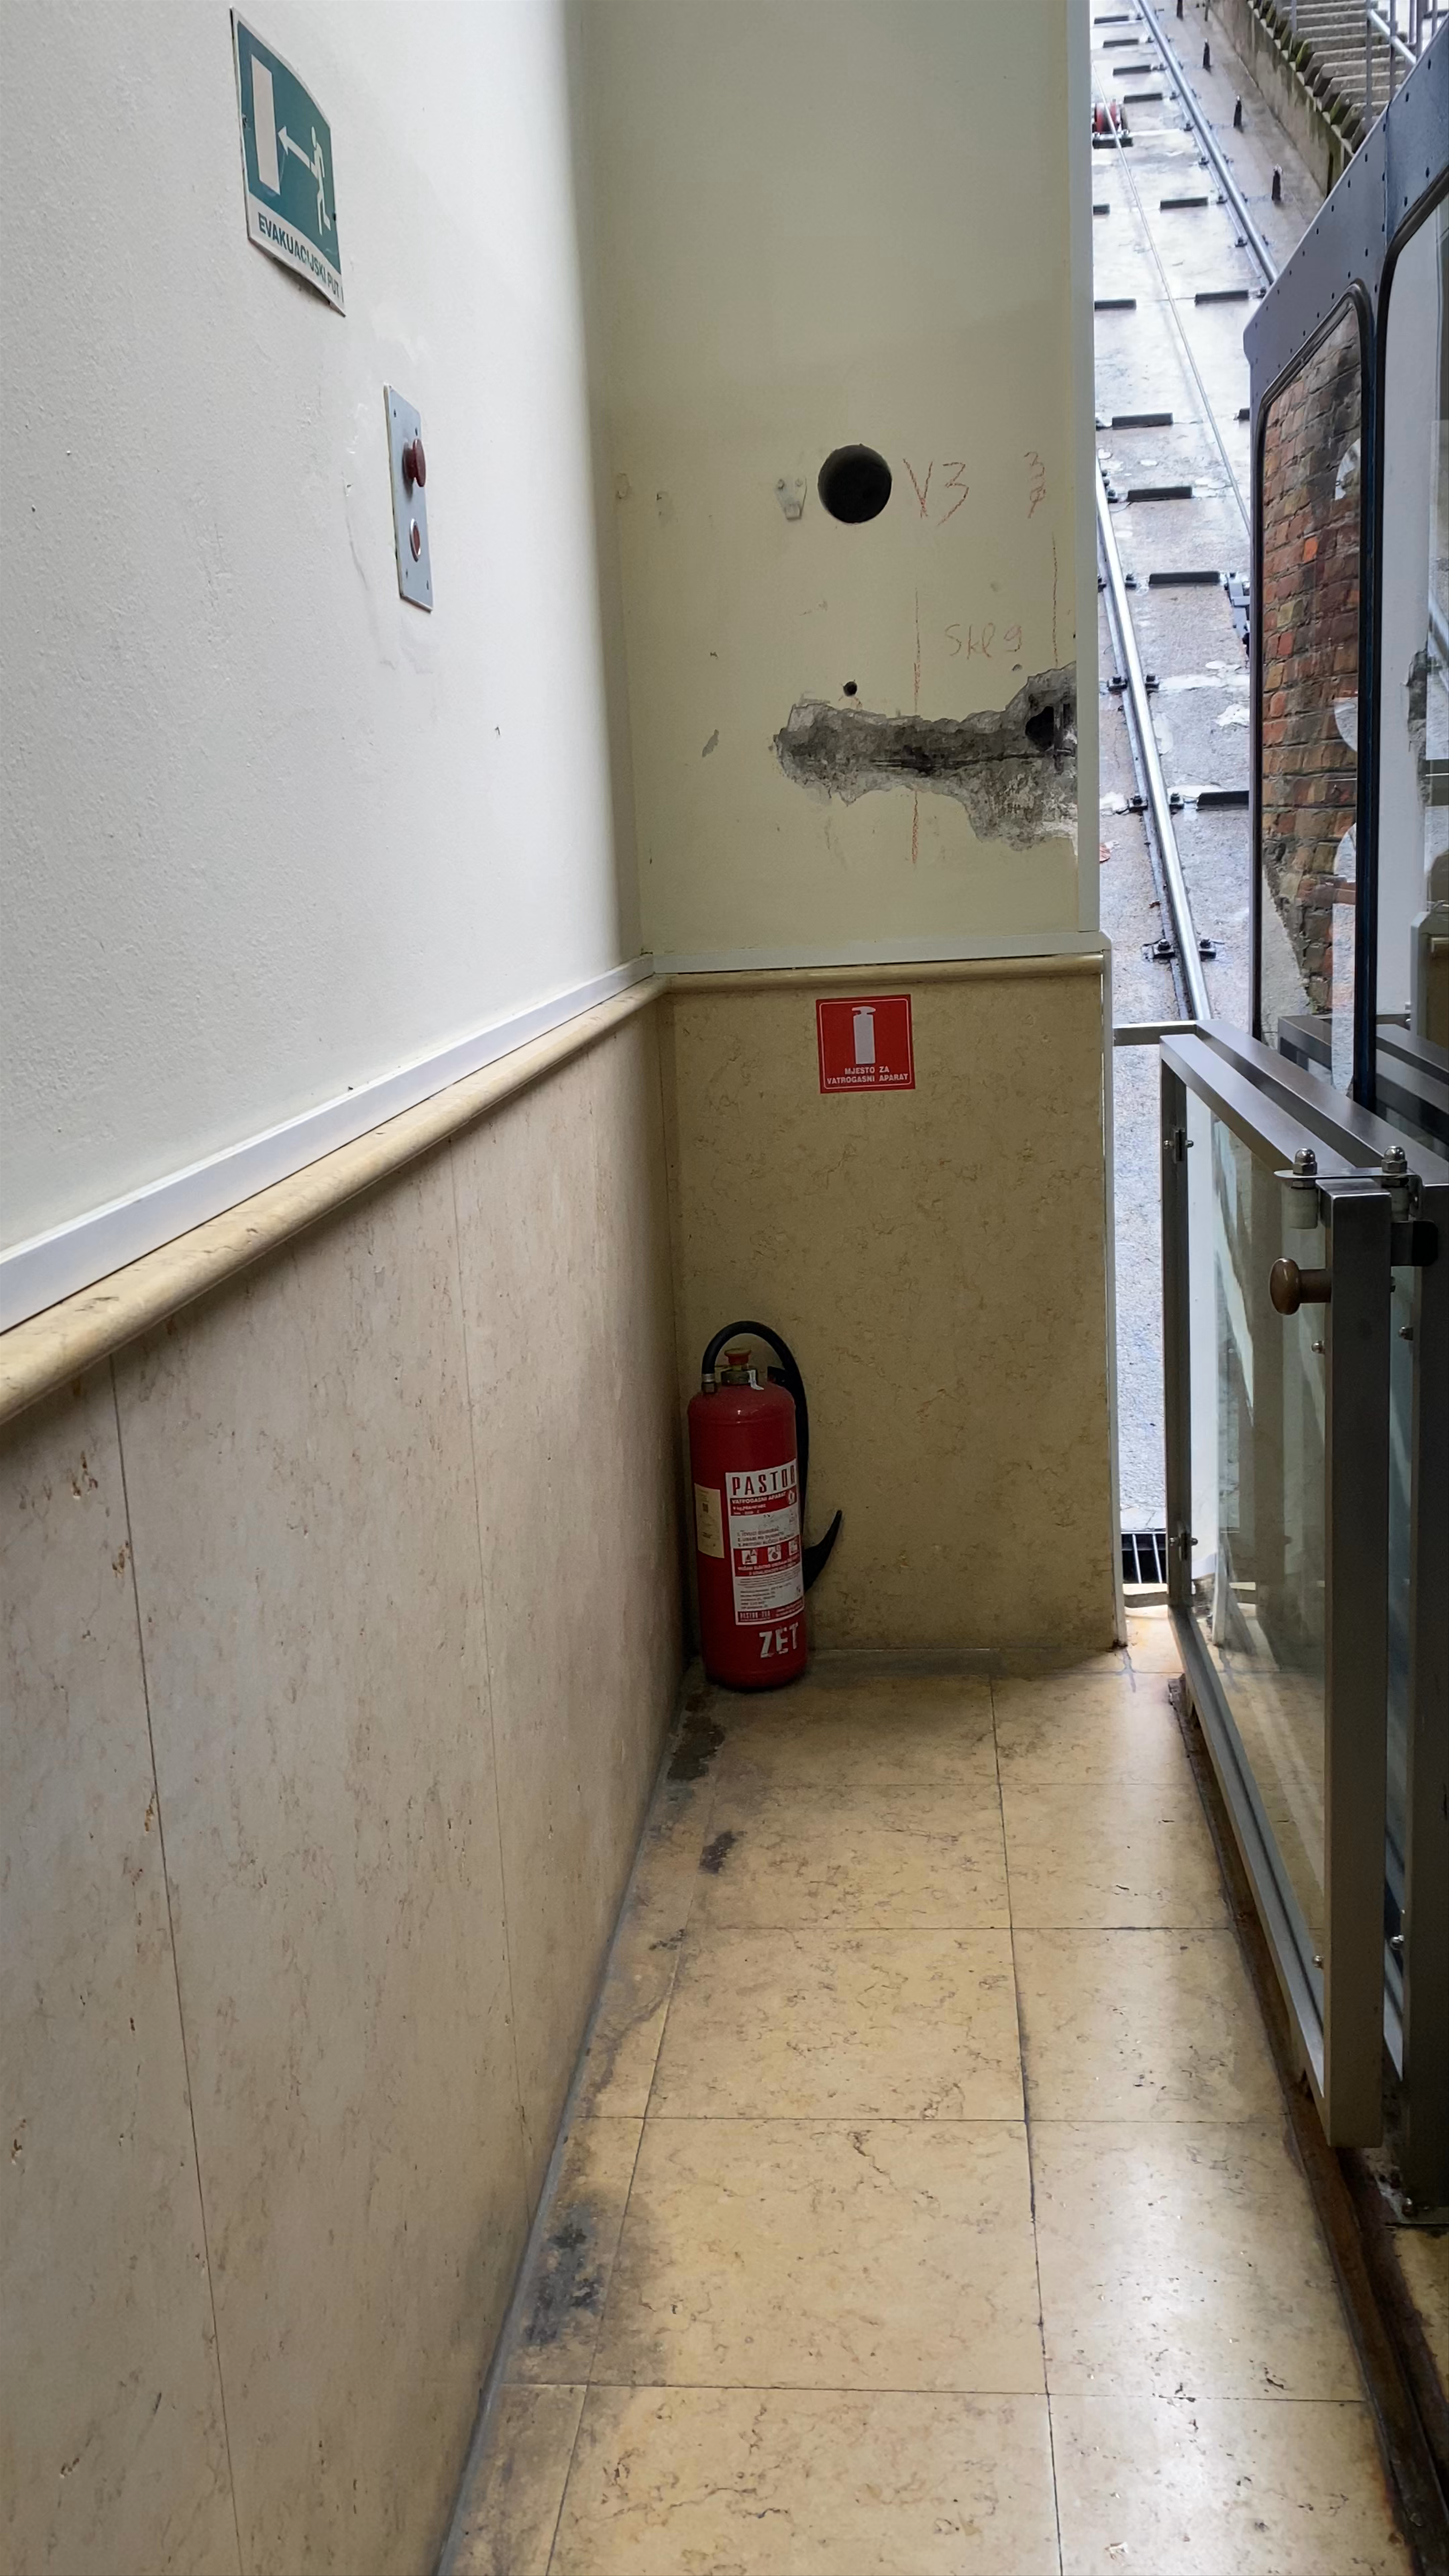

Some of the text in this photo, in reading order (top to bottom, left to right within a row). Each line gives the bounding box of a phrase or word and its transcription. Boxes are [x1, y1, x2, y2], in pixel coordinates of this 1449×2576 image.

[258, 212, 326, 283] EVAKUACIJSKI
[328, 271, 339, 298] PUT
[827, 1073, 908, 1084] VATROGASNI APARAT
[759, 1622, 798, 1658] ZET
